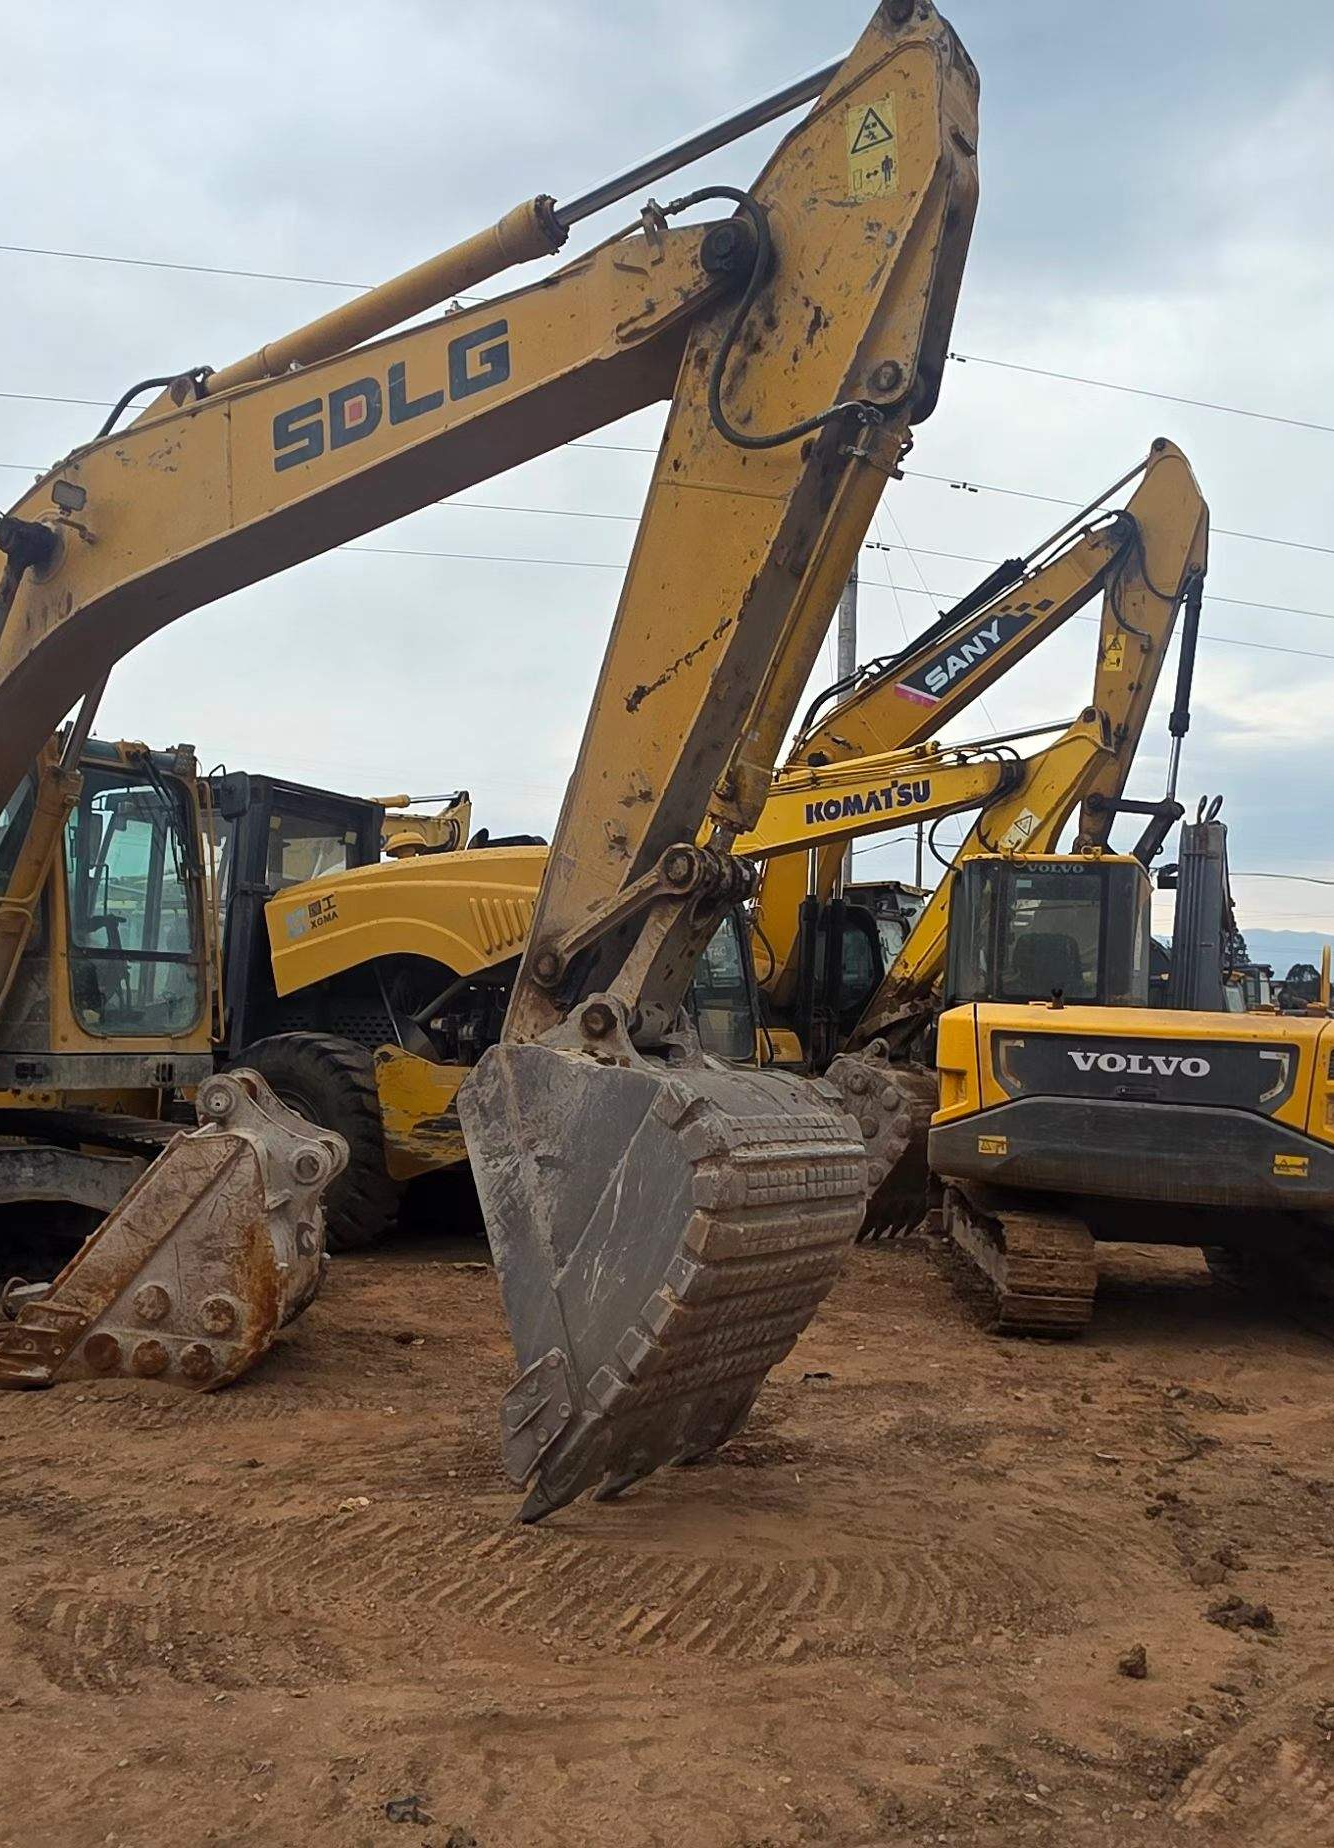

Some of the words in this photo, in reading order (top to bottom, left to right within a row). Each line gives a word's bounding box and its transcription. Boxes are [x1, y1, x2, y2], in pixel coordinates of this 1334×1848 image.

[273, 319, 510, 473] SDLG
[925, 619, 1000, 693] SANY
[805, 779, 931, 824] KOMATSU
[1027, 863, 1084, 874] VOLVO
[1067, 1051, 1210, 1077] VOLVO
